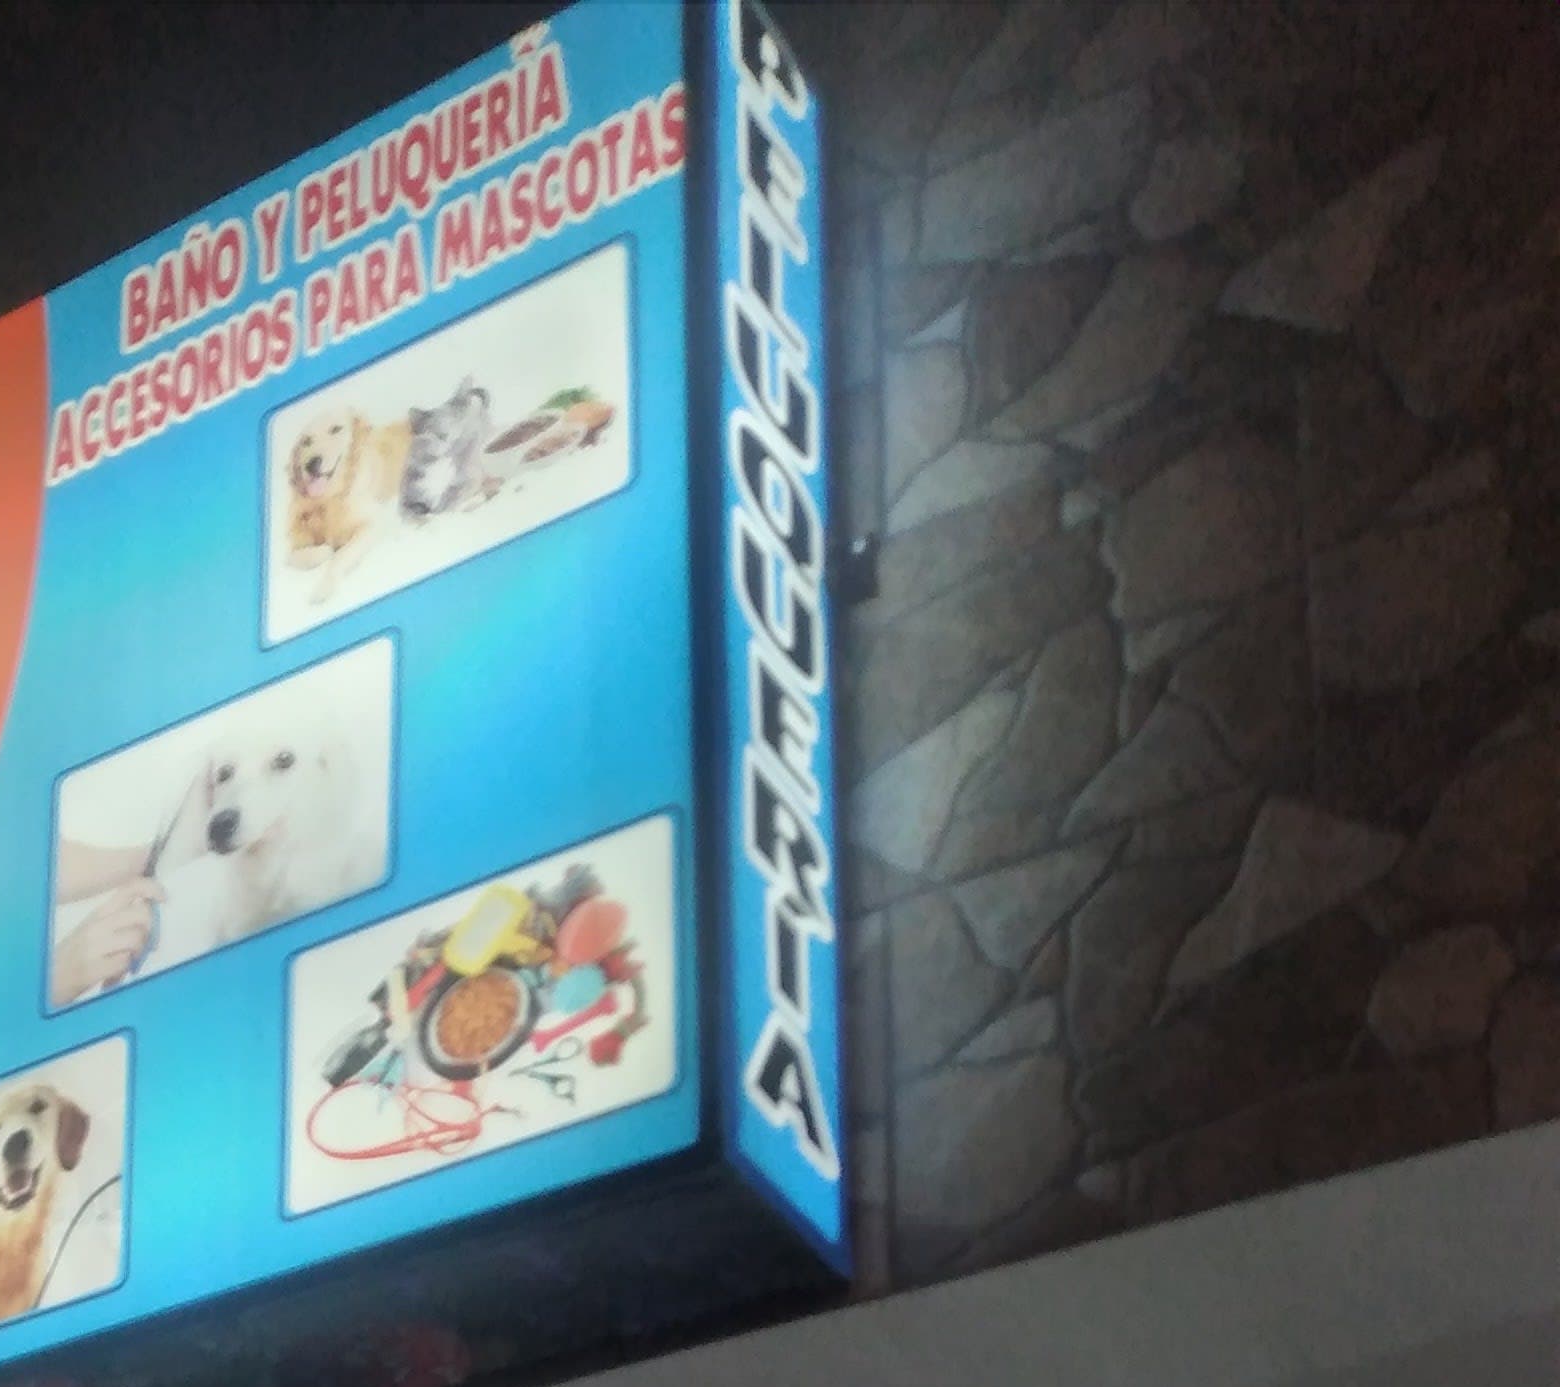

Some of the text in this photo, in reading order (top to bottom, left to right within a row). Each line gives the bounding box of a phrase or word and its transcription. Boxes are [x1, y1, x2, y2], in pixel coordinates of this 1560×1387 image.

[49, 84, 686, 482] ACCESORIOS PARA MASCOTAS
[125, 228, 243, 352] BAÑO
[258, 199, 288, 281] Y
